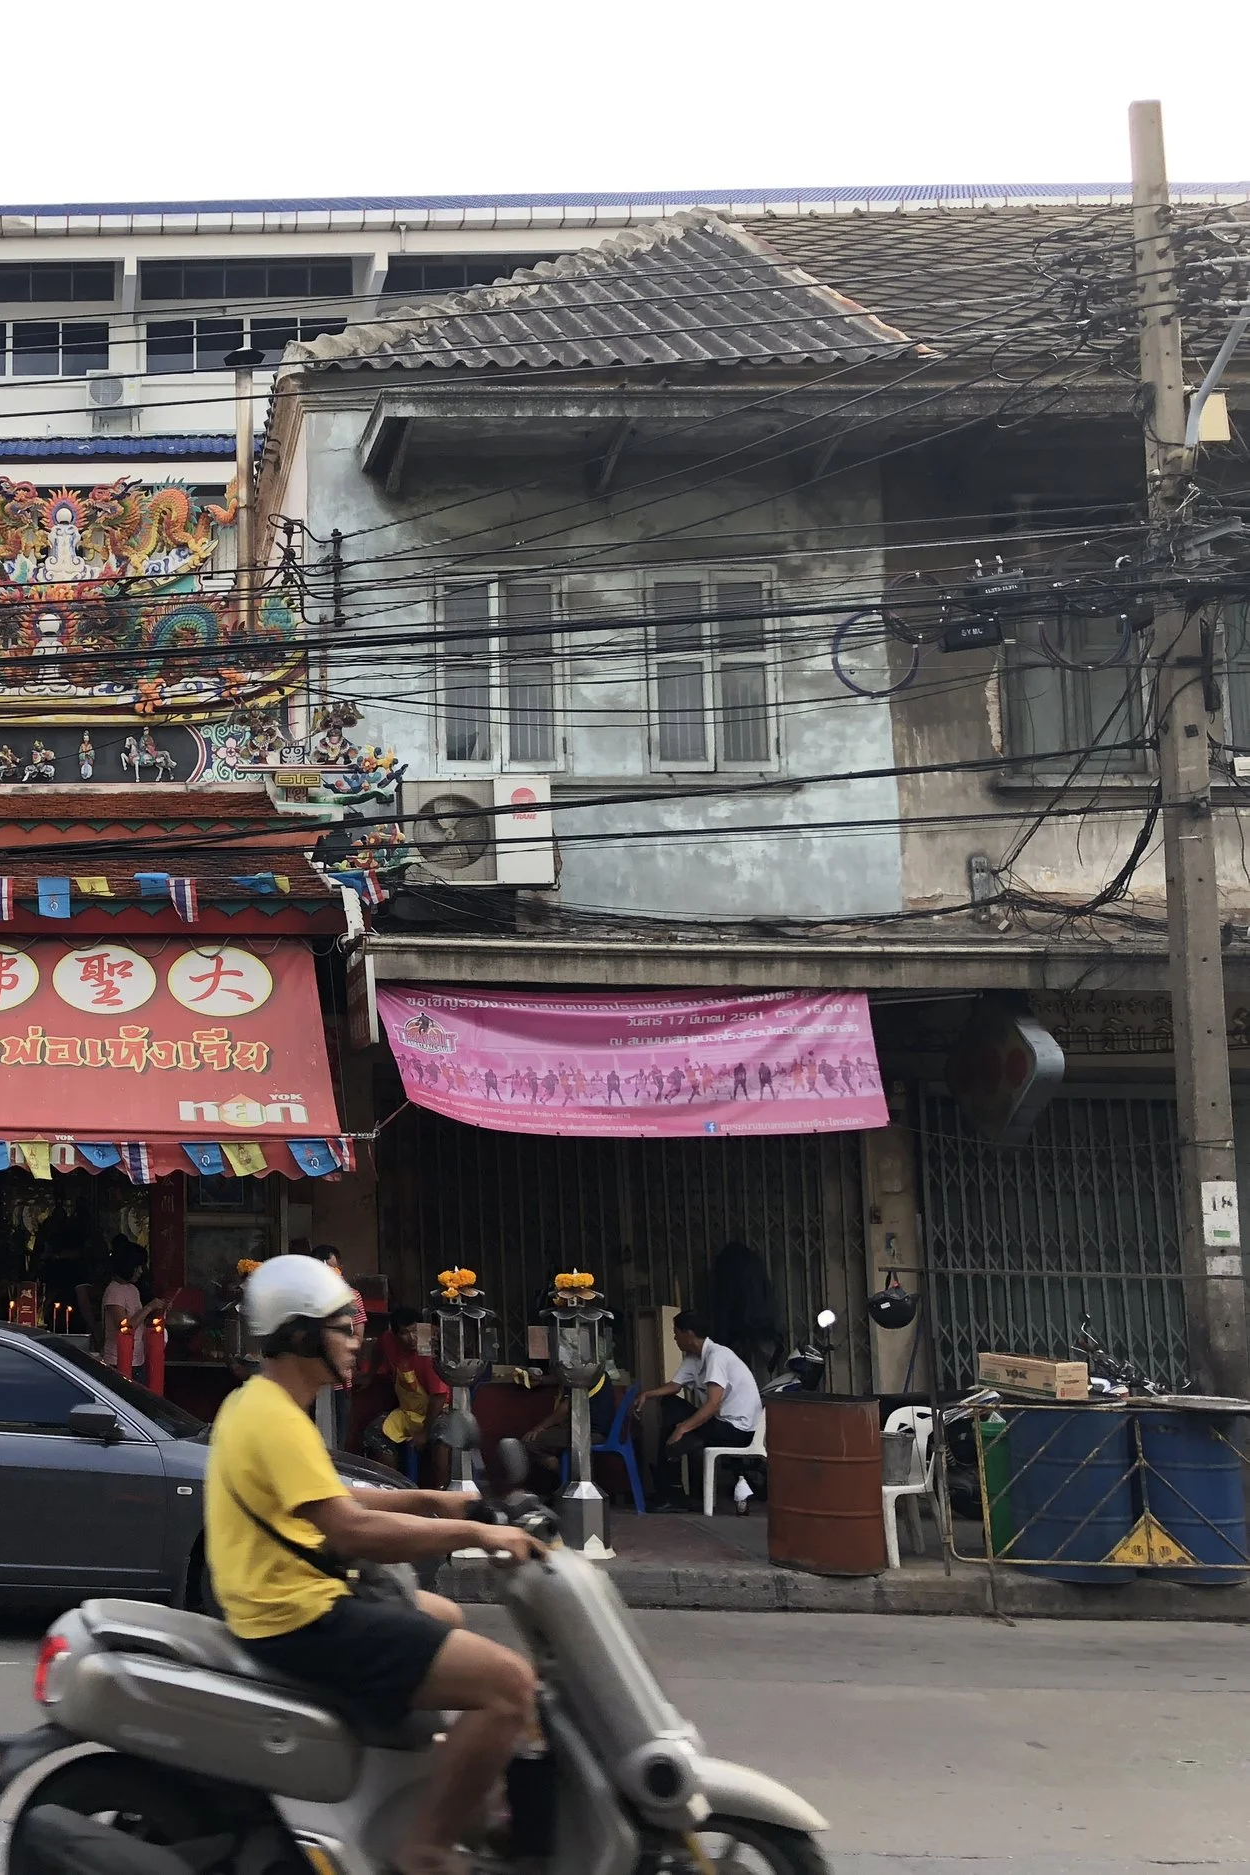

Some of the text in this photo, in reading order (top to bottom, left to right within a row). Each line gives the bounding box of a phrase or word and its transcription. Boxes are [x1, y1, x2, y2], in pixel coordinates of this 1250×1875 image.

[668, 1015, 686, 1026] 17
[690, 1013, 726, 1025] มีนาคม
[729, 1012, 764, 1022] 2561
[805, 1004, 843, 1014] 16.00
[269, 1093, 303, 1101] YOK
